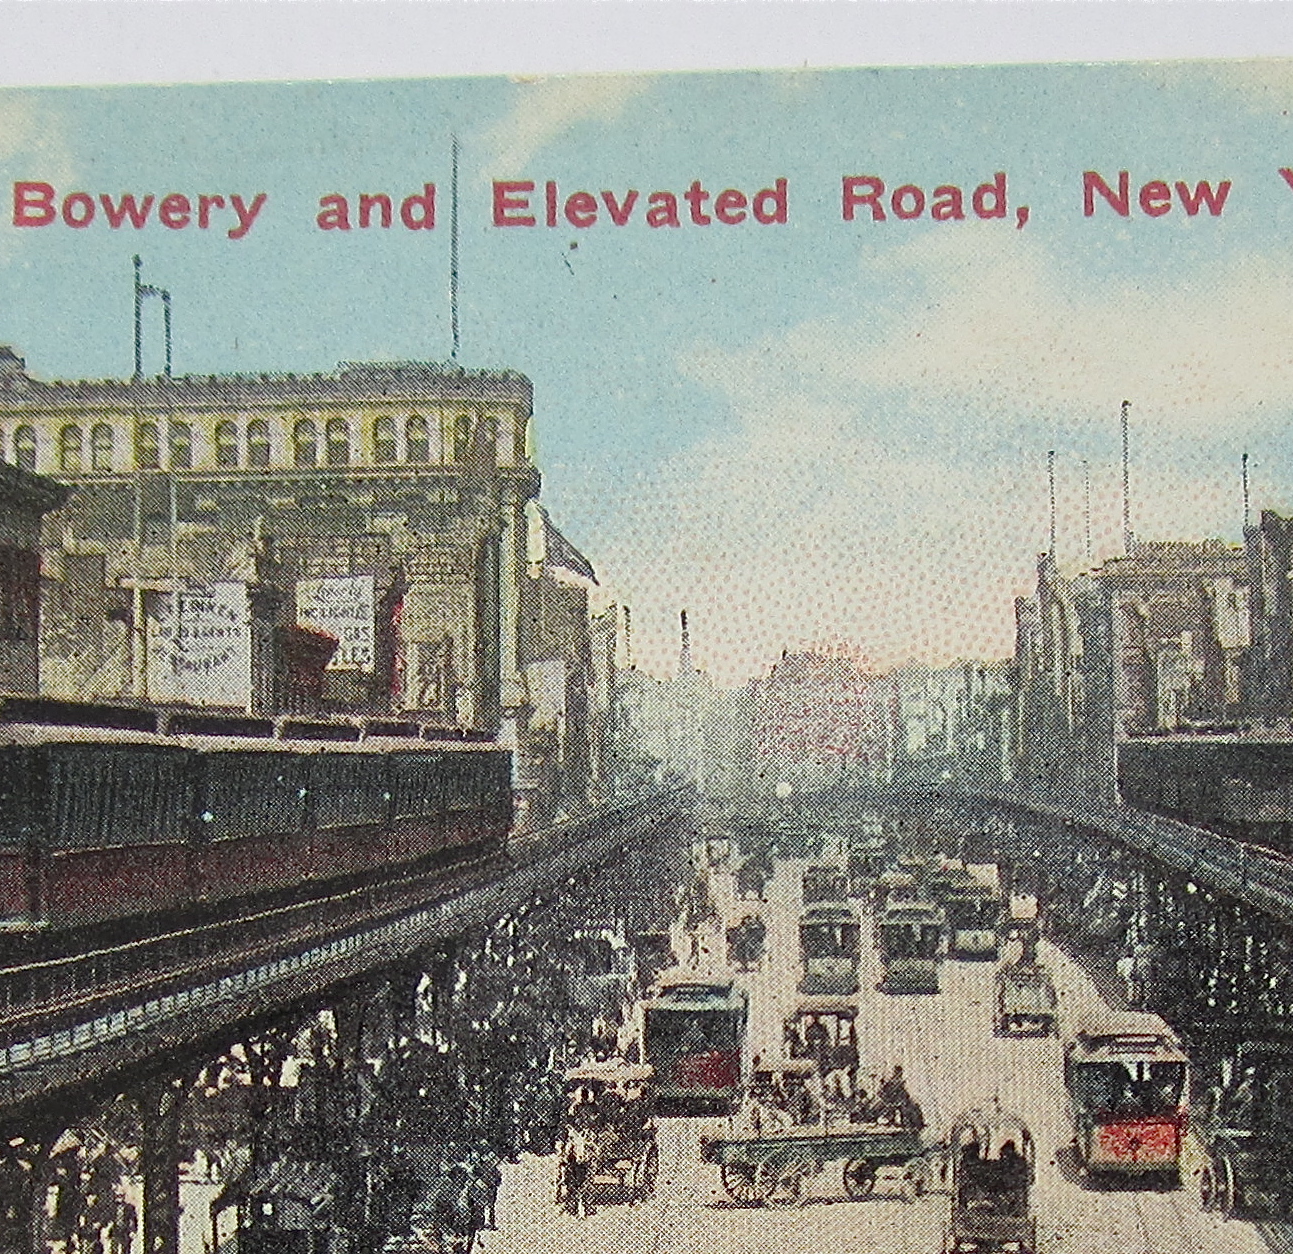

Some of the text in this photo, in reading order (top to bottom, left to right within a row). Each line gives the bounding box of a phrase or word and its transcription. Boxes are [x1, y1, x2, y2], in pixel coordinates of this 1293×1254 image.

[12, 181, 267, 240] Bowery
[317, 183, 437, 231] and
[491, 178, 789, 229] Elevated
[841, 172, 1030, 230] Road,
[1081, 169, 1233, 219] New
